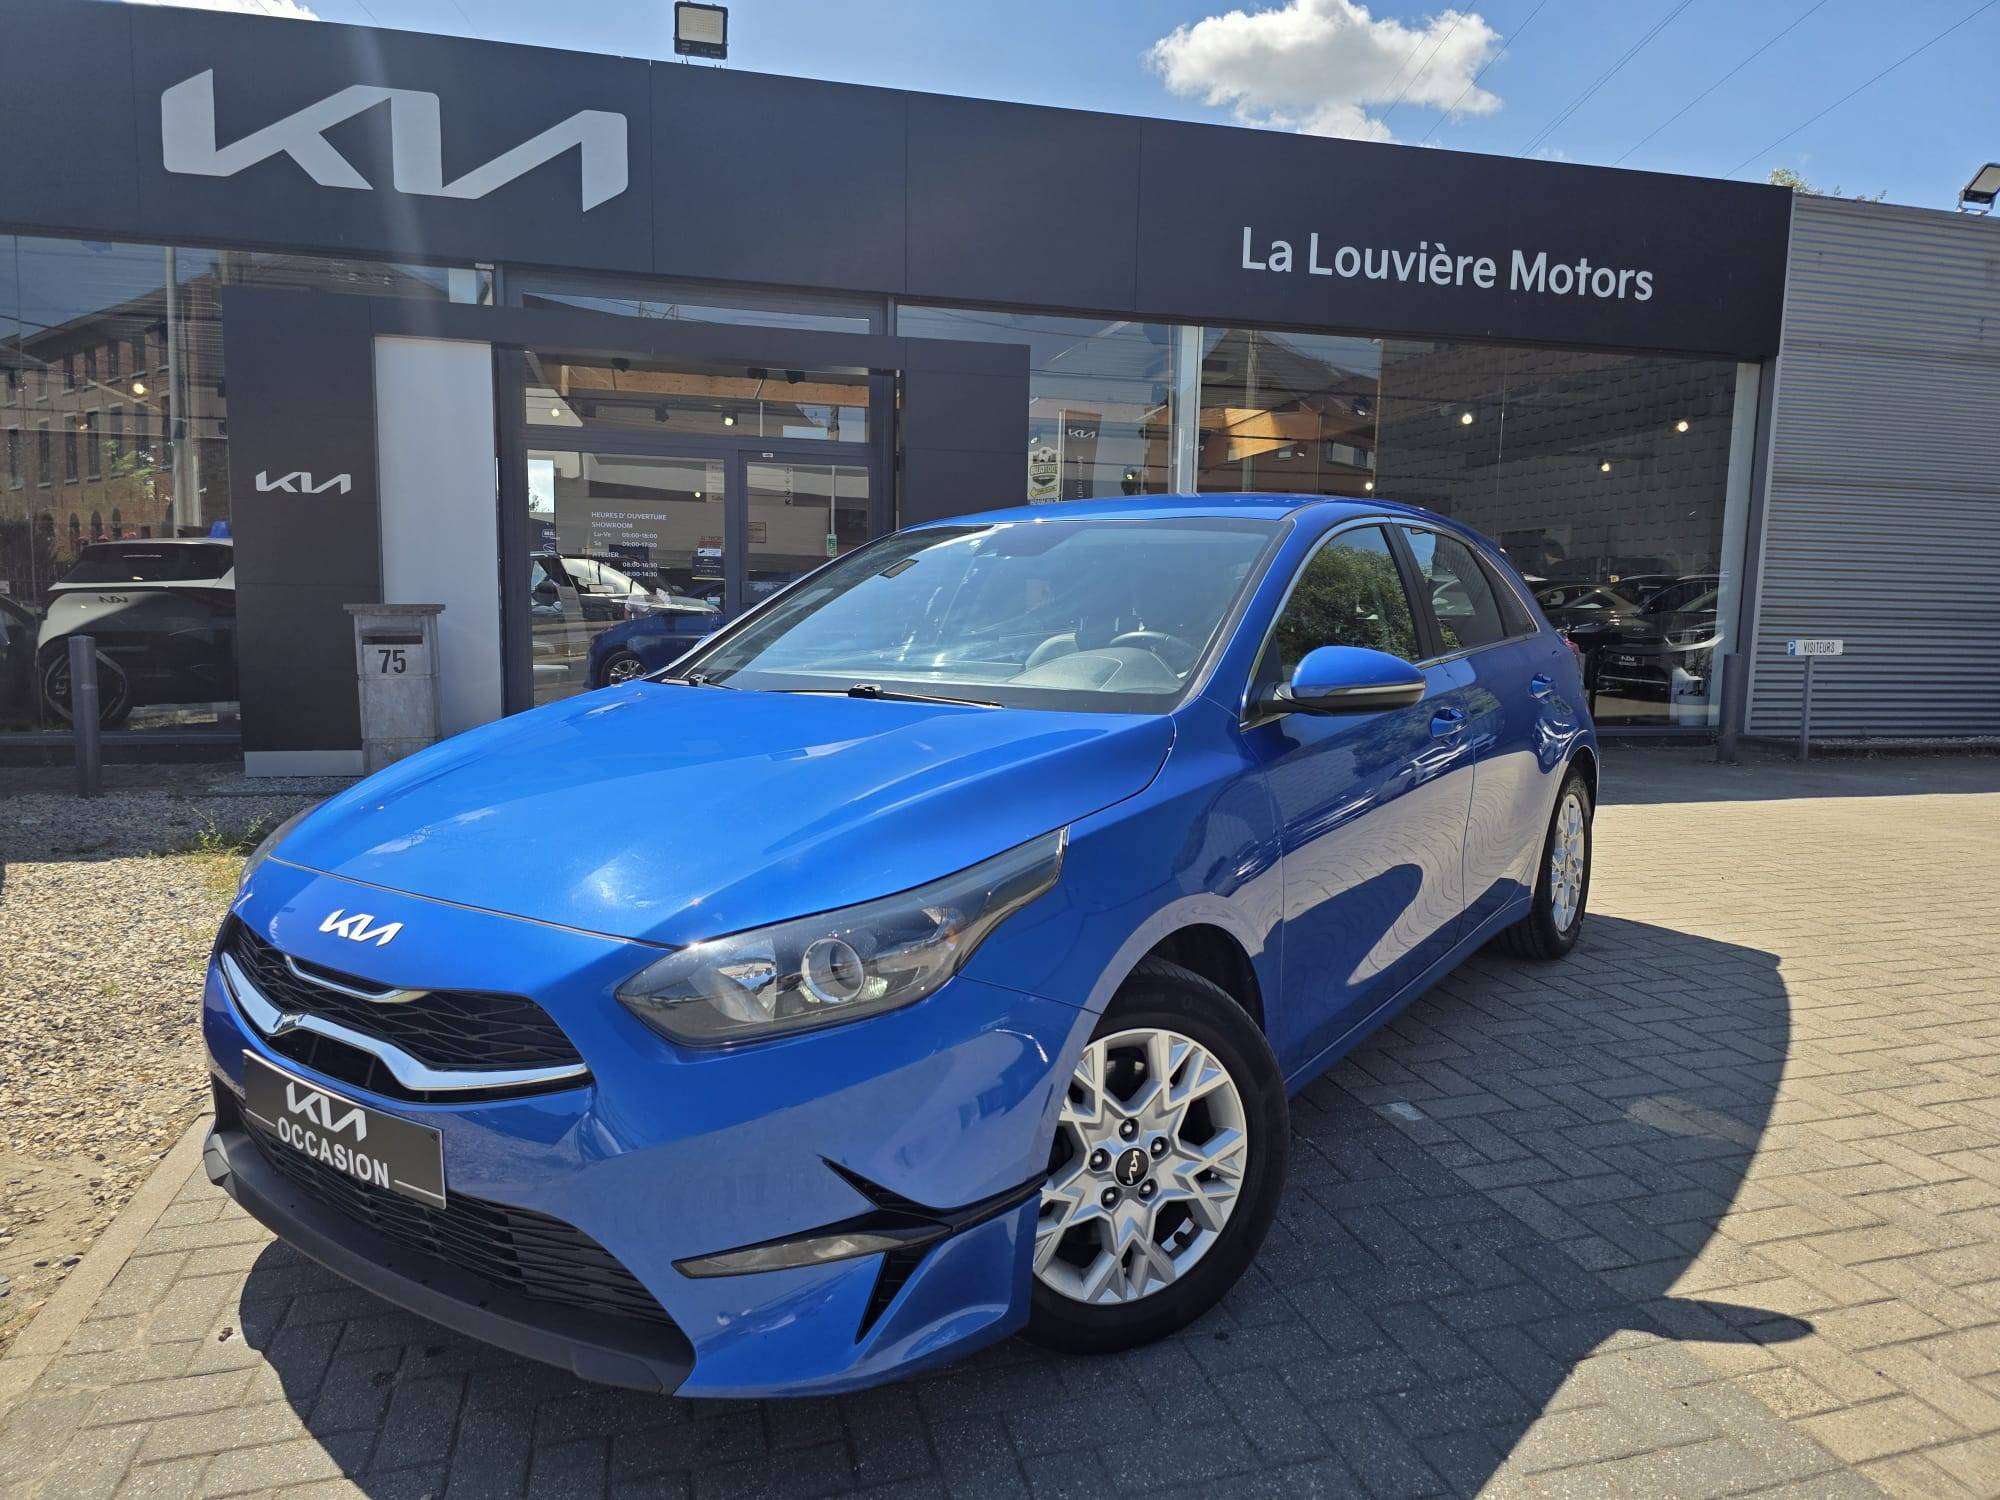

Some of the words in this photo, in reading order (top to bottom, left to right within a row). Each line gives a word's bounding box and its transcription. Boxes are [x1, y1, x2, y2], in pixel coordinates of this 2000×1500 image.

[161, 68, 628, 213] KIA
[1241, 226, 1293, 272] La
[1308, 232, 1497, 288] Louvière
[1509, 249, 1654, 301] Motors
[255, 470, 351, 495] KIA
[377, 649, 407, 674] 75
[1803, 641, 1835, 654] VISITEURS
[318, 908, 404, 947] KIA
[285, 1081, 367, 1142] KIA
[277, 1116, 390, 1189] OCCASION
